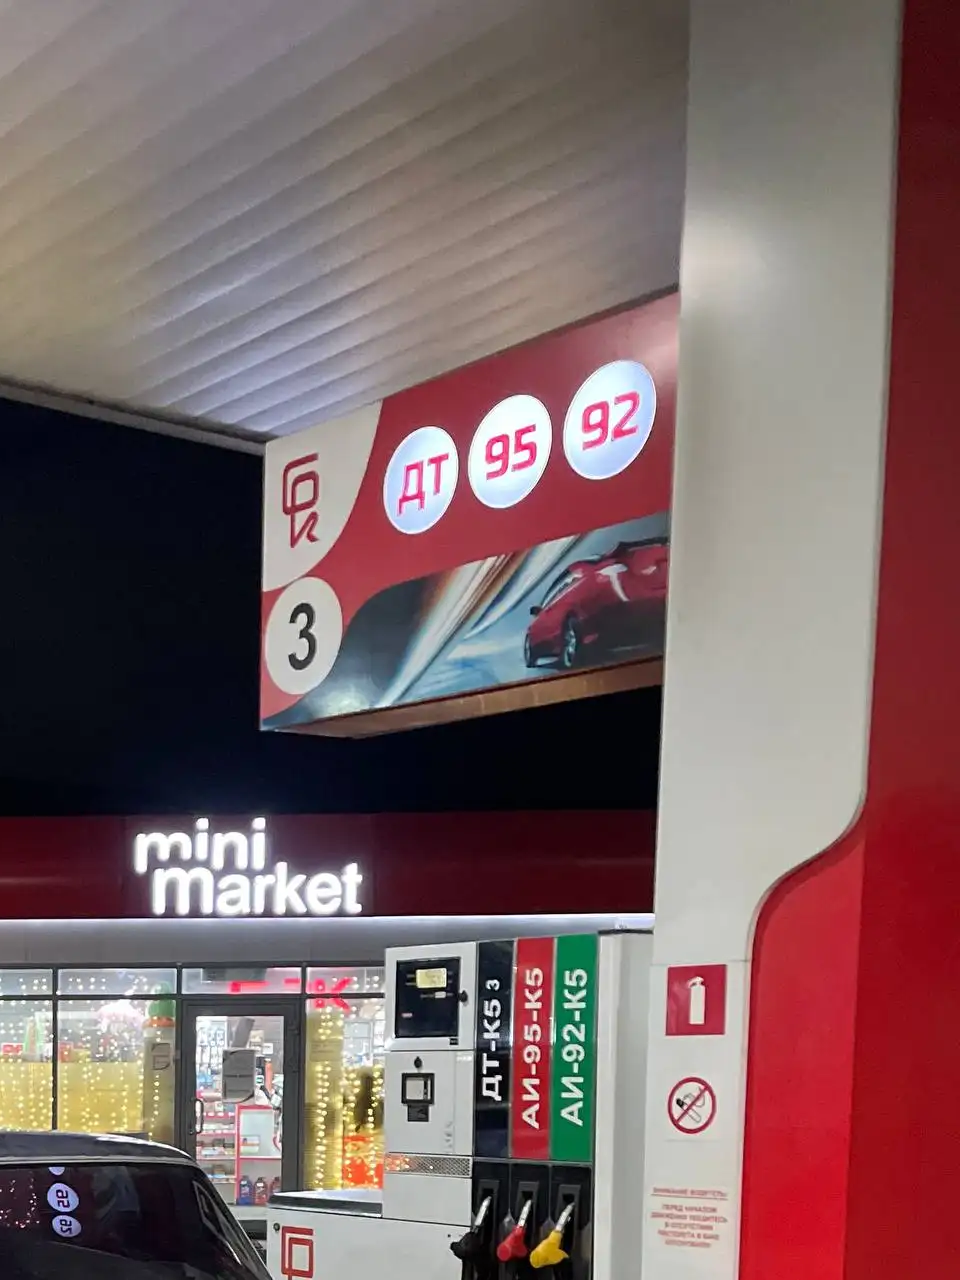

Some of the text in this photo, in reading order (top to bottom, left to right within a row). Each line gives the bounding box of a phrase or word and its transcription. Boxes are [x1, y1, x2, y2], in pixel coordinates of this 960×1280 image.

[397, 391, 639, 515] ДТ 95 92
[288, 602, 317, 670] 3
[134, 817, 267, 874] mini
[152, 861, 363, 916] market
[482, 998, 502, 1102] ДТ-К5
[522, 967, 544, 1129] АИ-95-К5
[560, 968, 588, 1126] АИ-92-К5
